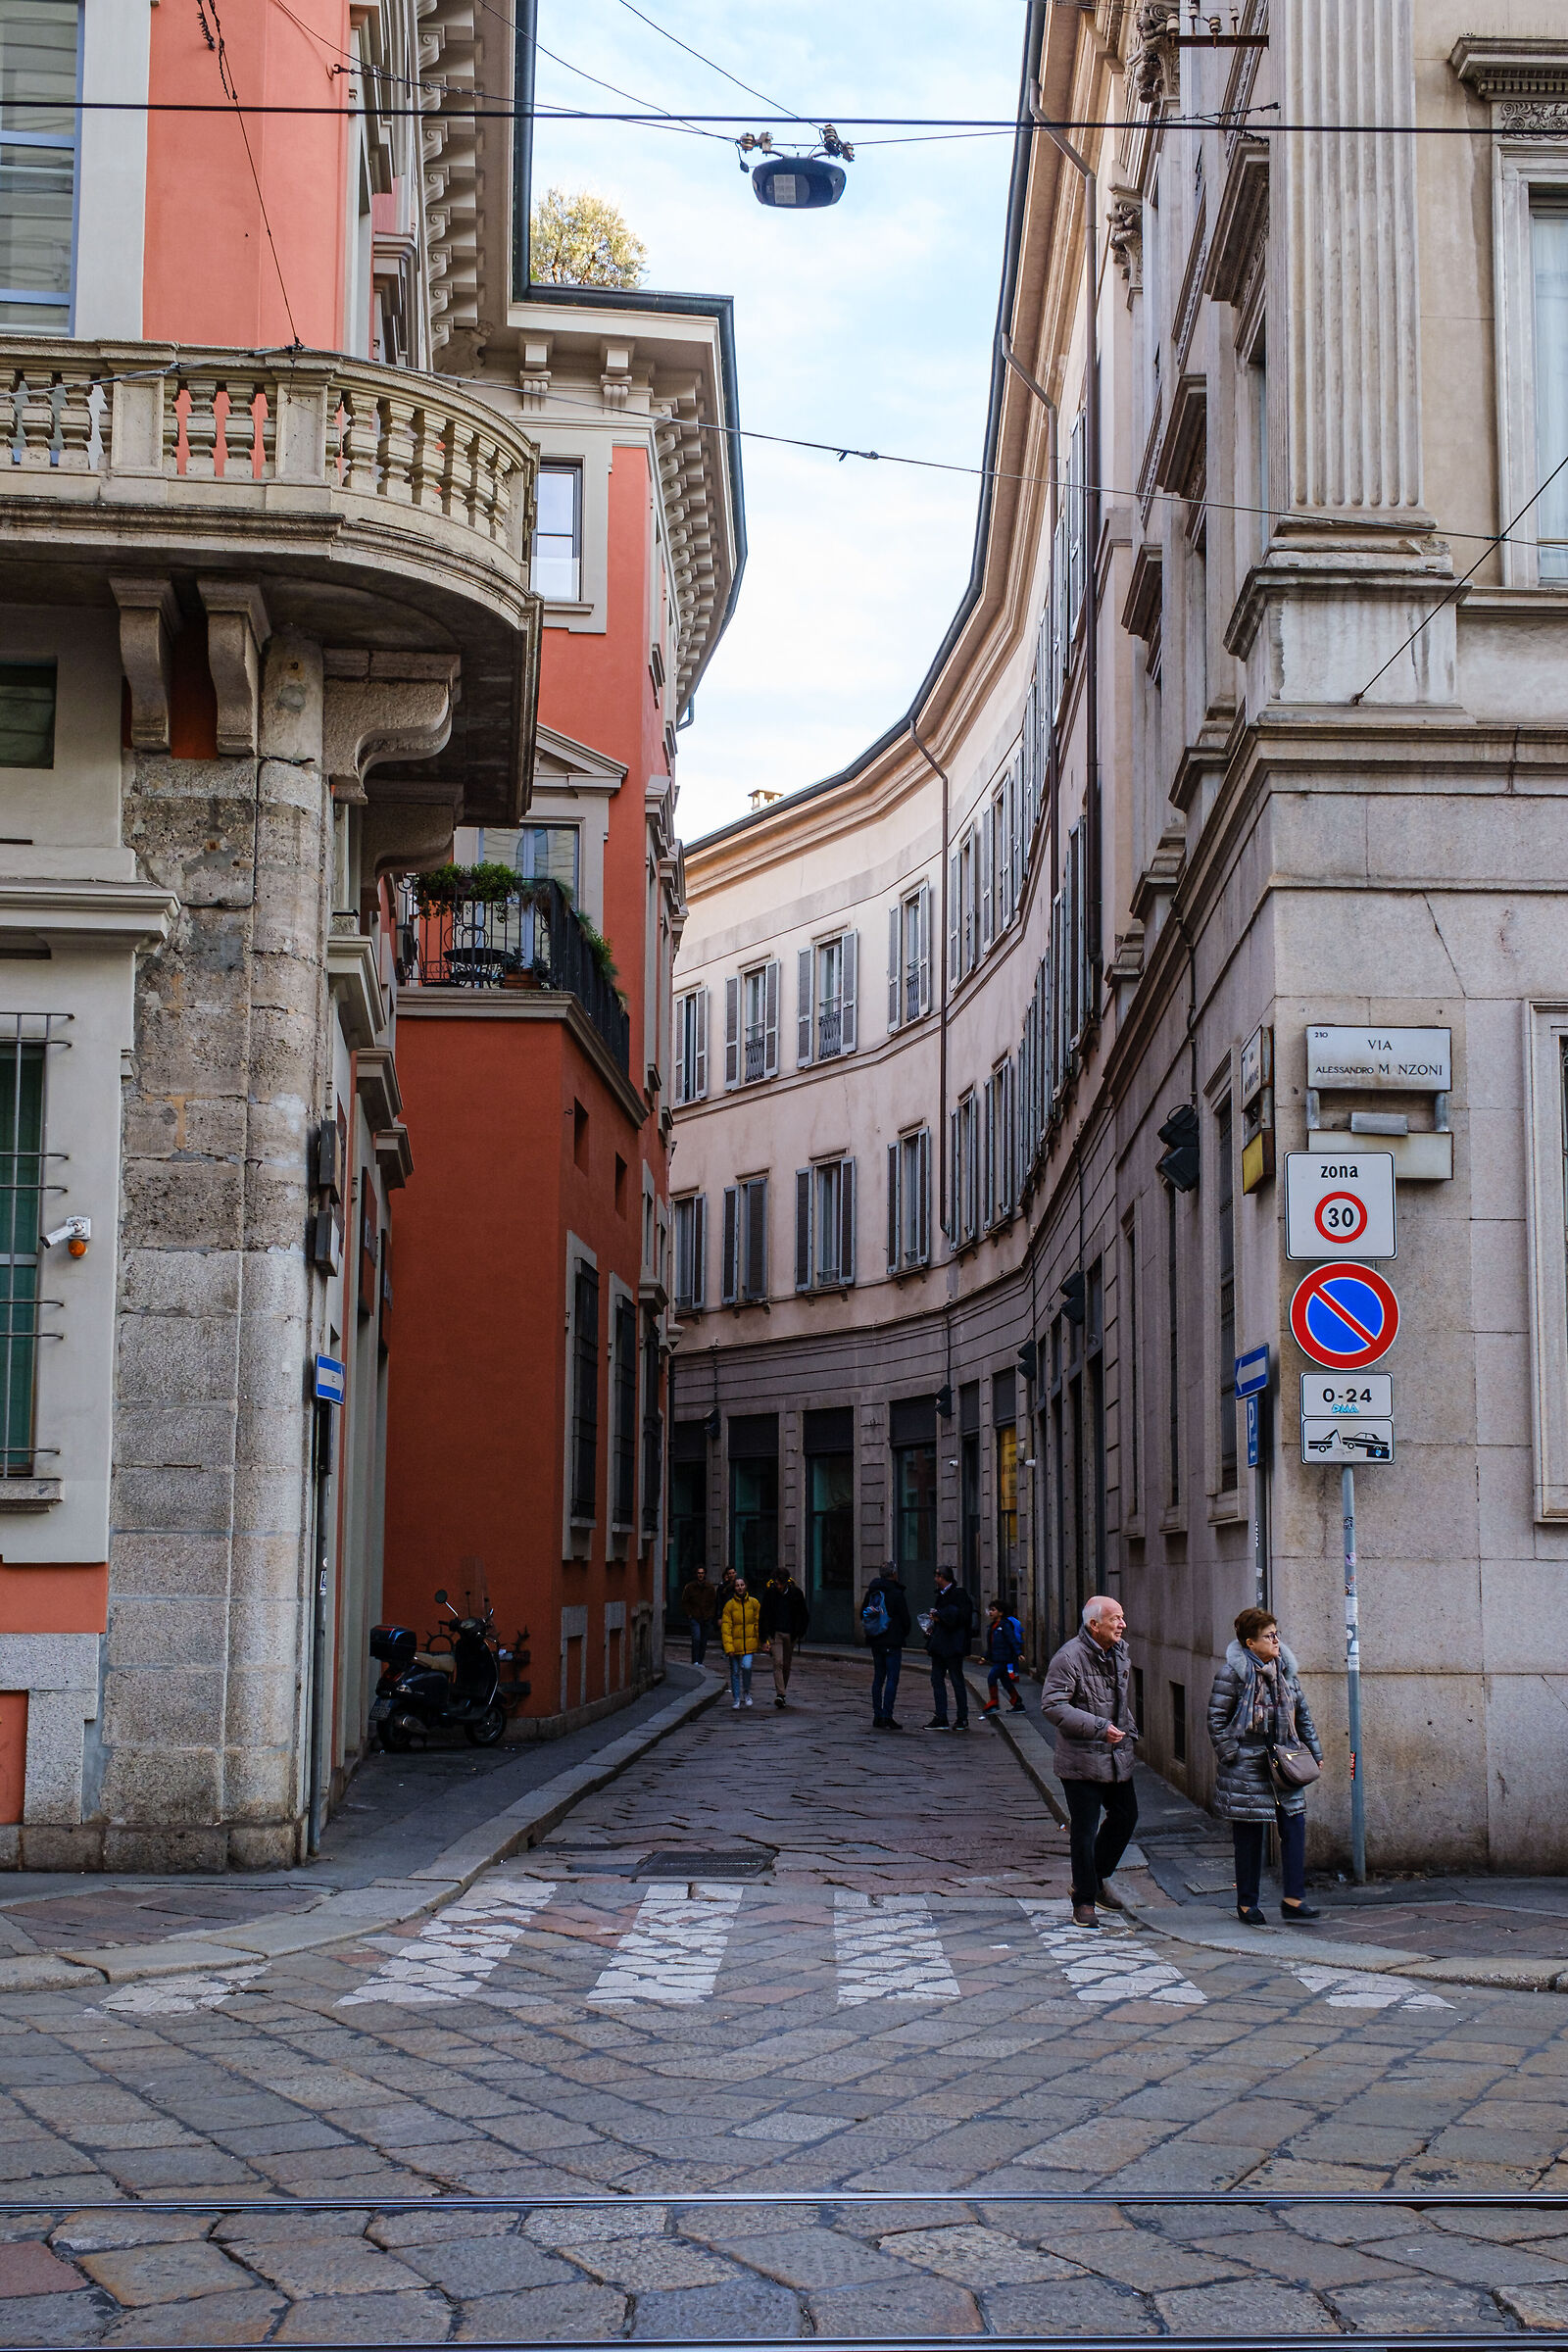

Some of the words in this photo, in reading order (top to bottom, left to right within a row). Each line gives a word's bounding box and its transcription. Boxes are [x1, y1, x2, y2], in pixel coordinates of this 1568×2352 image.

[1368, 1040, 1393, 1051] VIA
[1378, 1063, 1443, 1076] MNZONI
[1320, 1165, 1359, 1179] zona
[1328, 1207, 1354, 1228] 30
